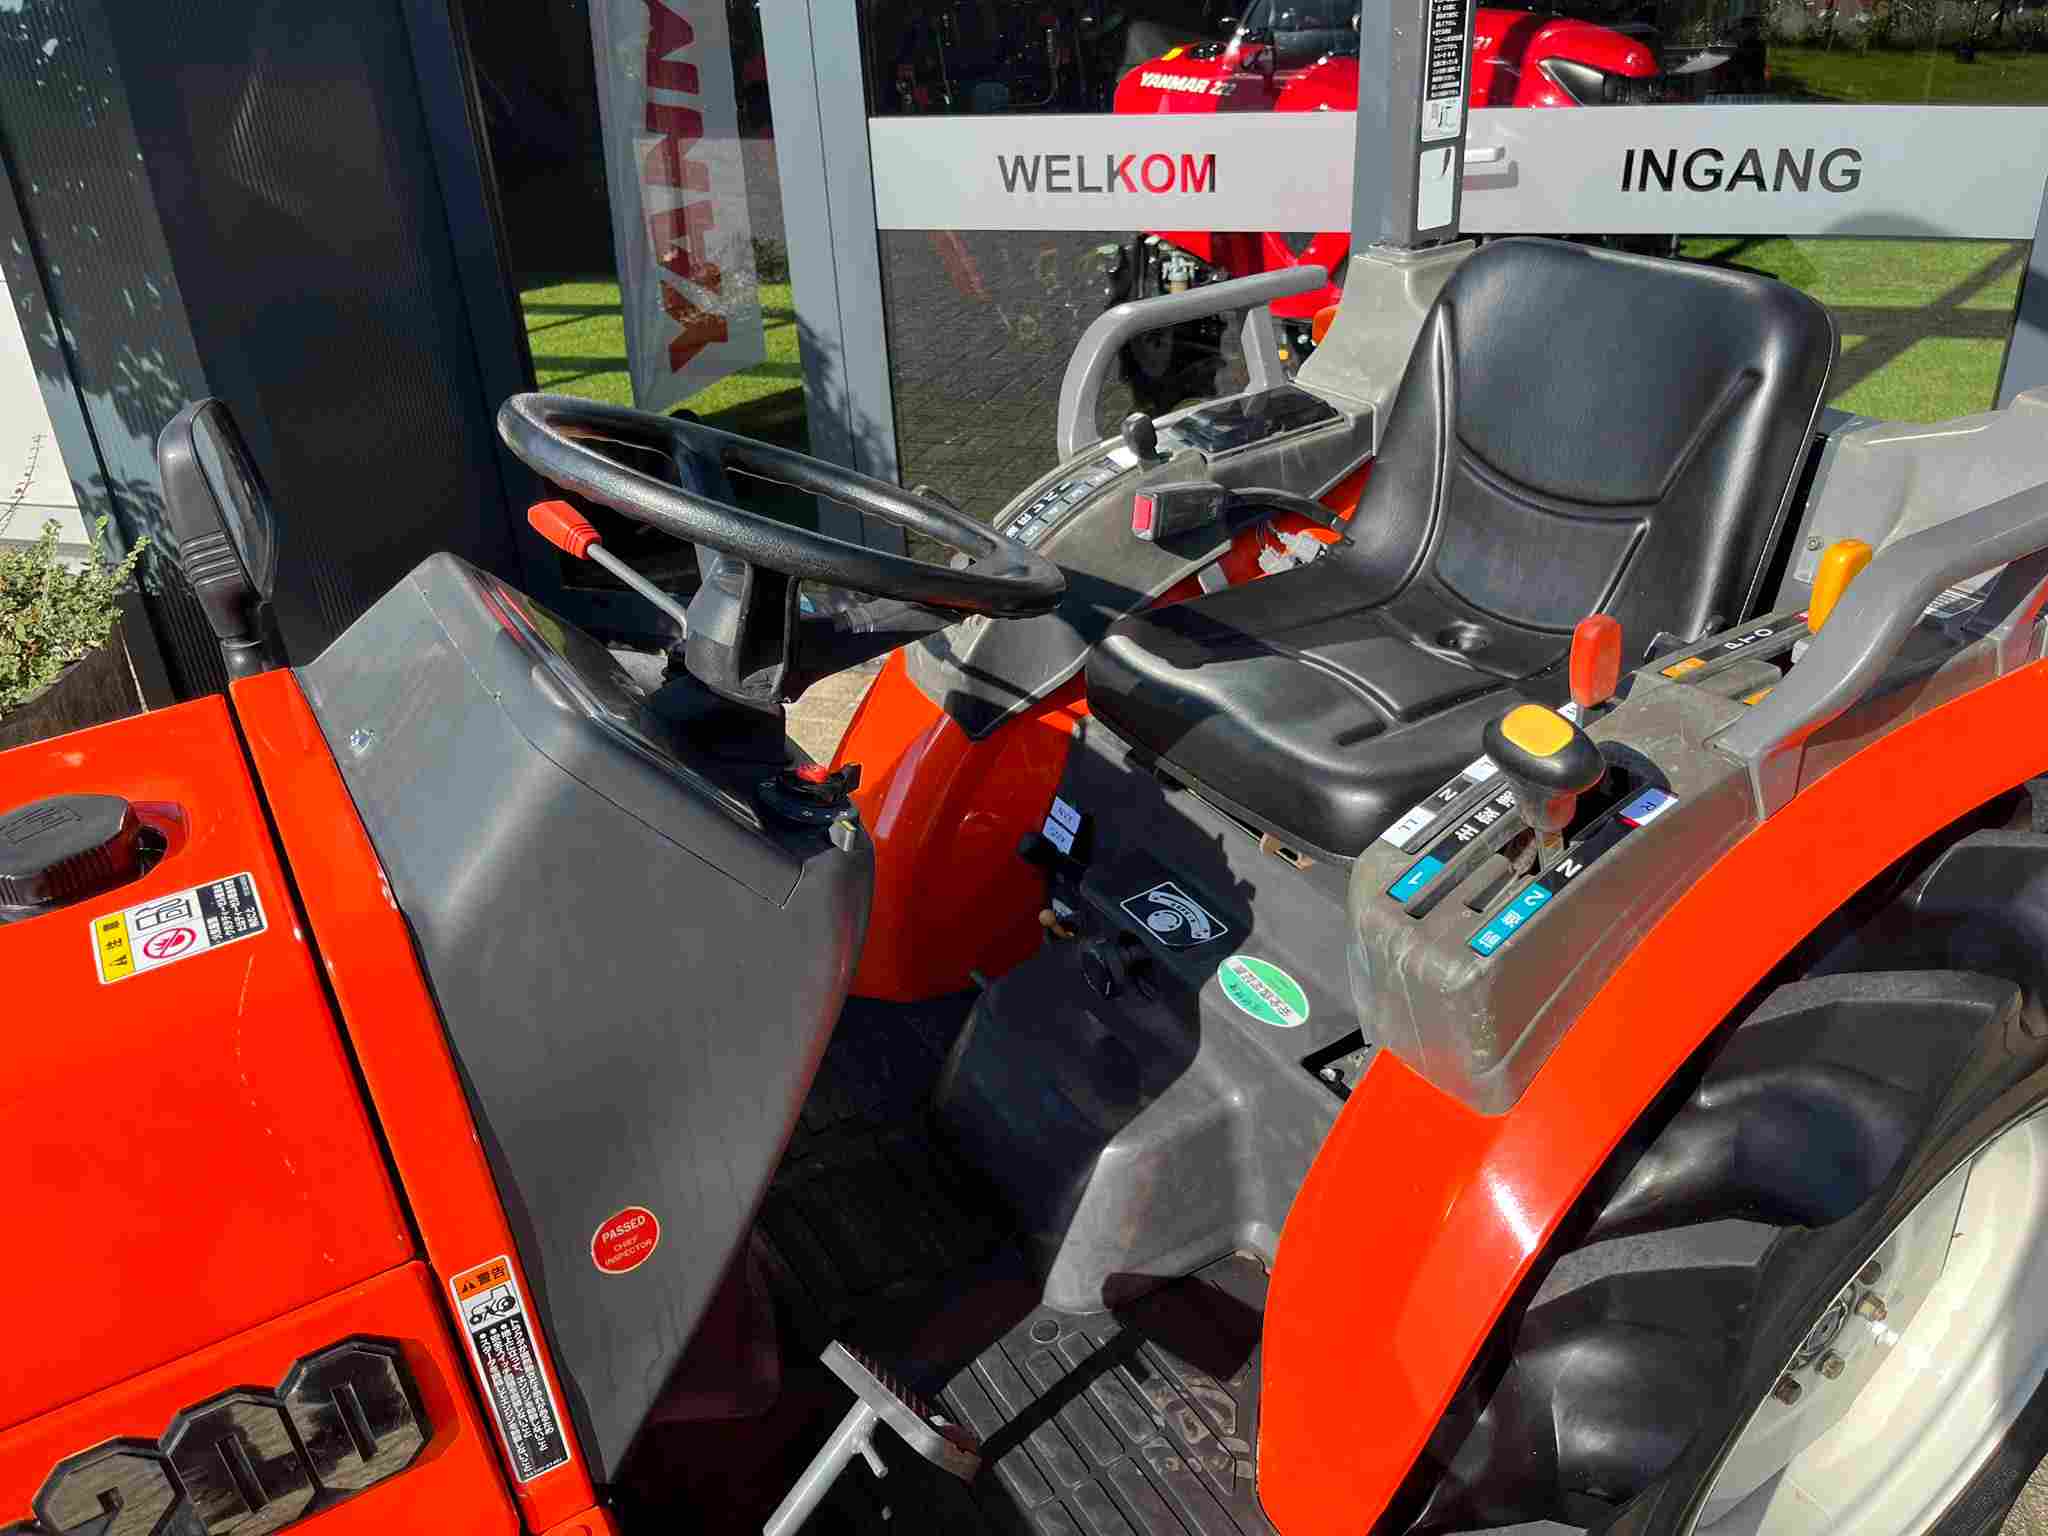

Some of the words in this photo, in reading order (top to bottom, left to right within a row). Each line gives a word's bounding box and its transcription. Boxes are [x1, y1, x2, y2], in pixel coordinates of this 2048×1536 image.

[1140, 72, 1209, 93] YANMAR
[997, 153, 1217, 195] WELKOM
[1621, 147, 1863, 193] INGANG
[1724, 628, 1773, 650] PTO
[1438, 788, 1457, 801] N
[1639, 800, 1657, 812] R
[1556, 858, 1583, 878] N
[601, 1215, 646, 1244] PASSED
